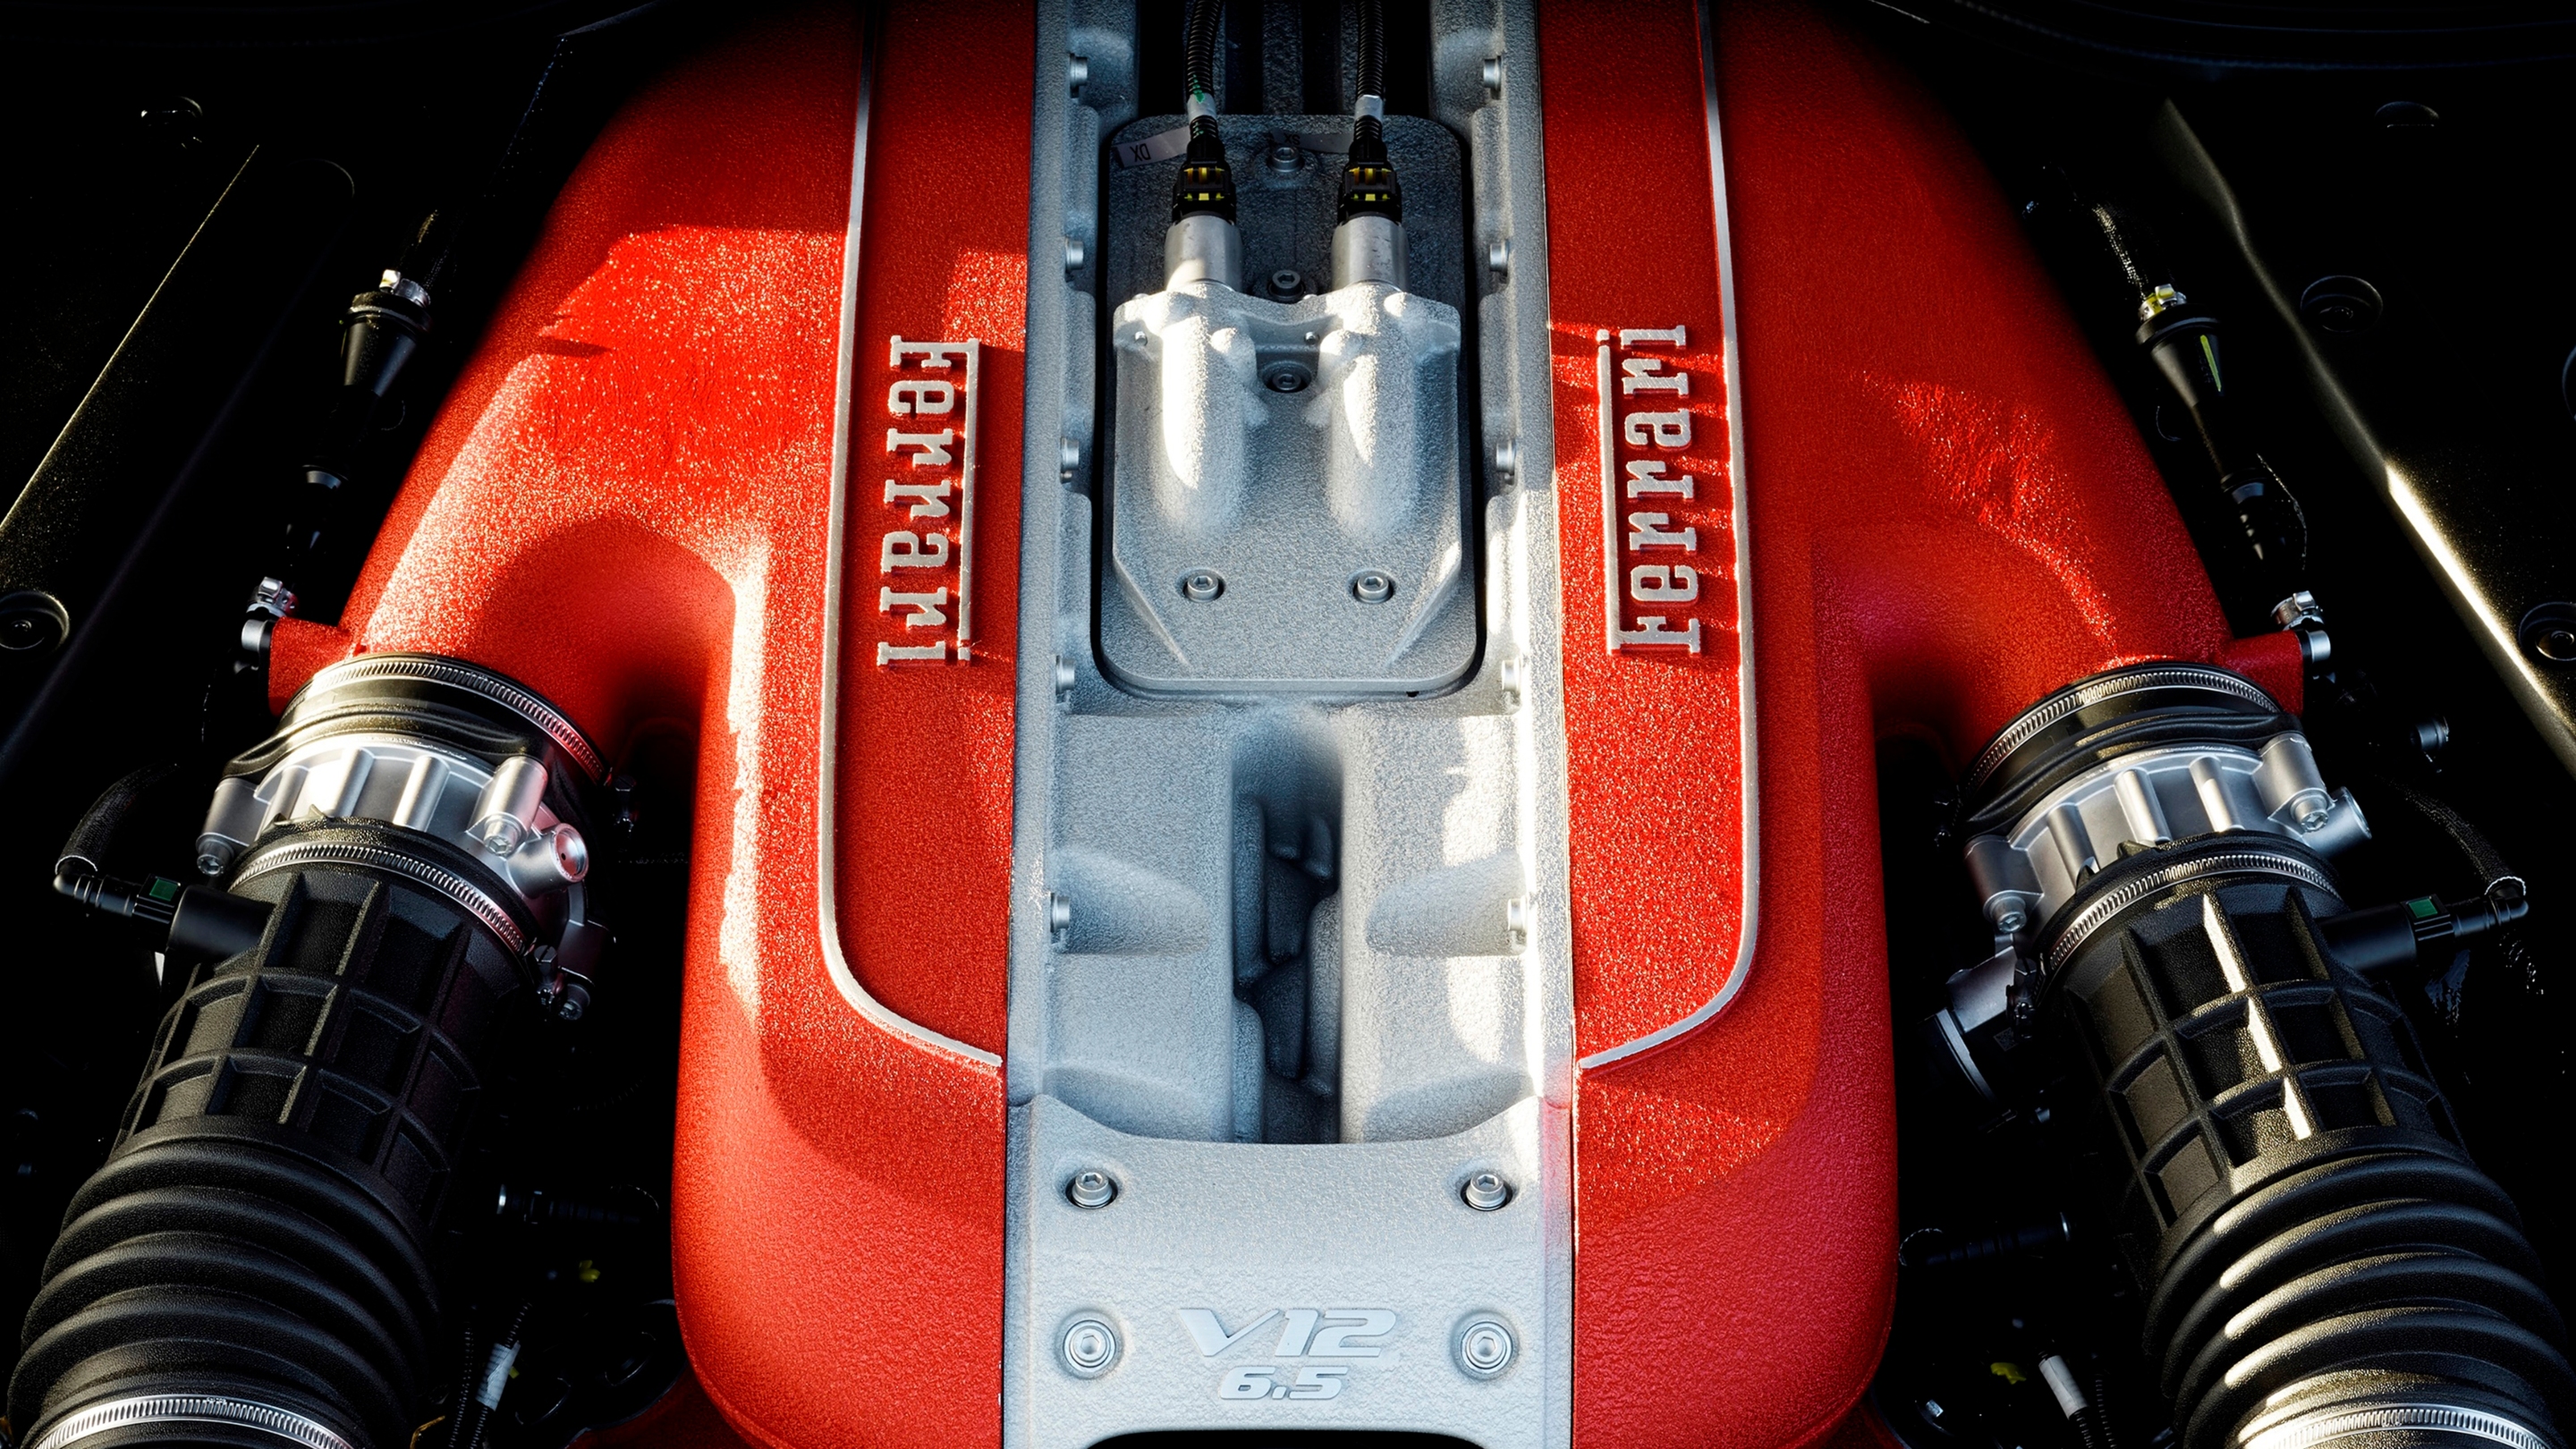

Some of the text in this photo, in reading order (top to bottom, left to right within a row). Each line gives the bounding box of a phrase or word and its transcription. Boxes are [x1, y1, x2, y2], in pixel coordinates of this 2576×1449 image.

[1130, 143, 1151, 162] DX
[1284, 132, 1301, 145] SX
[876, 335, 979, 666] Ferrari
[1597, 325, 1701, 656] Ferrari
[1178, 1308, 1396, 1358] V12
[1219, 1365, 1349, 1401] 6.5
